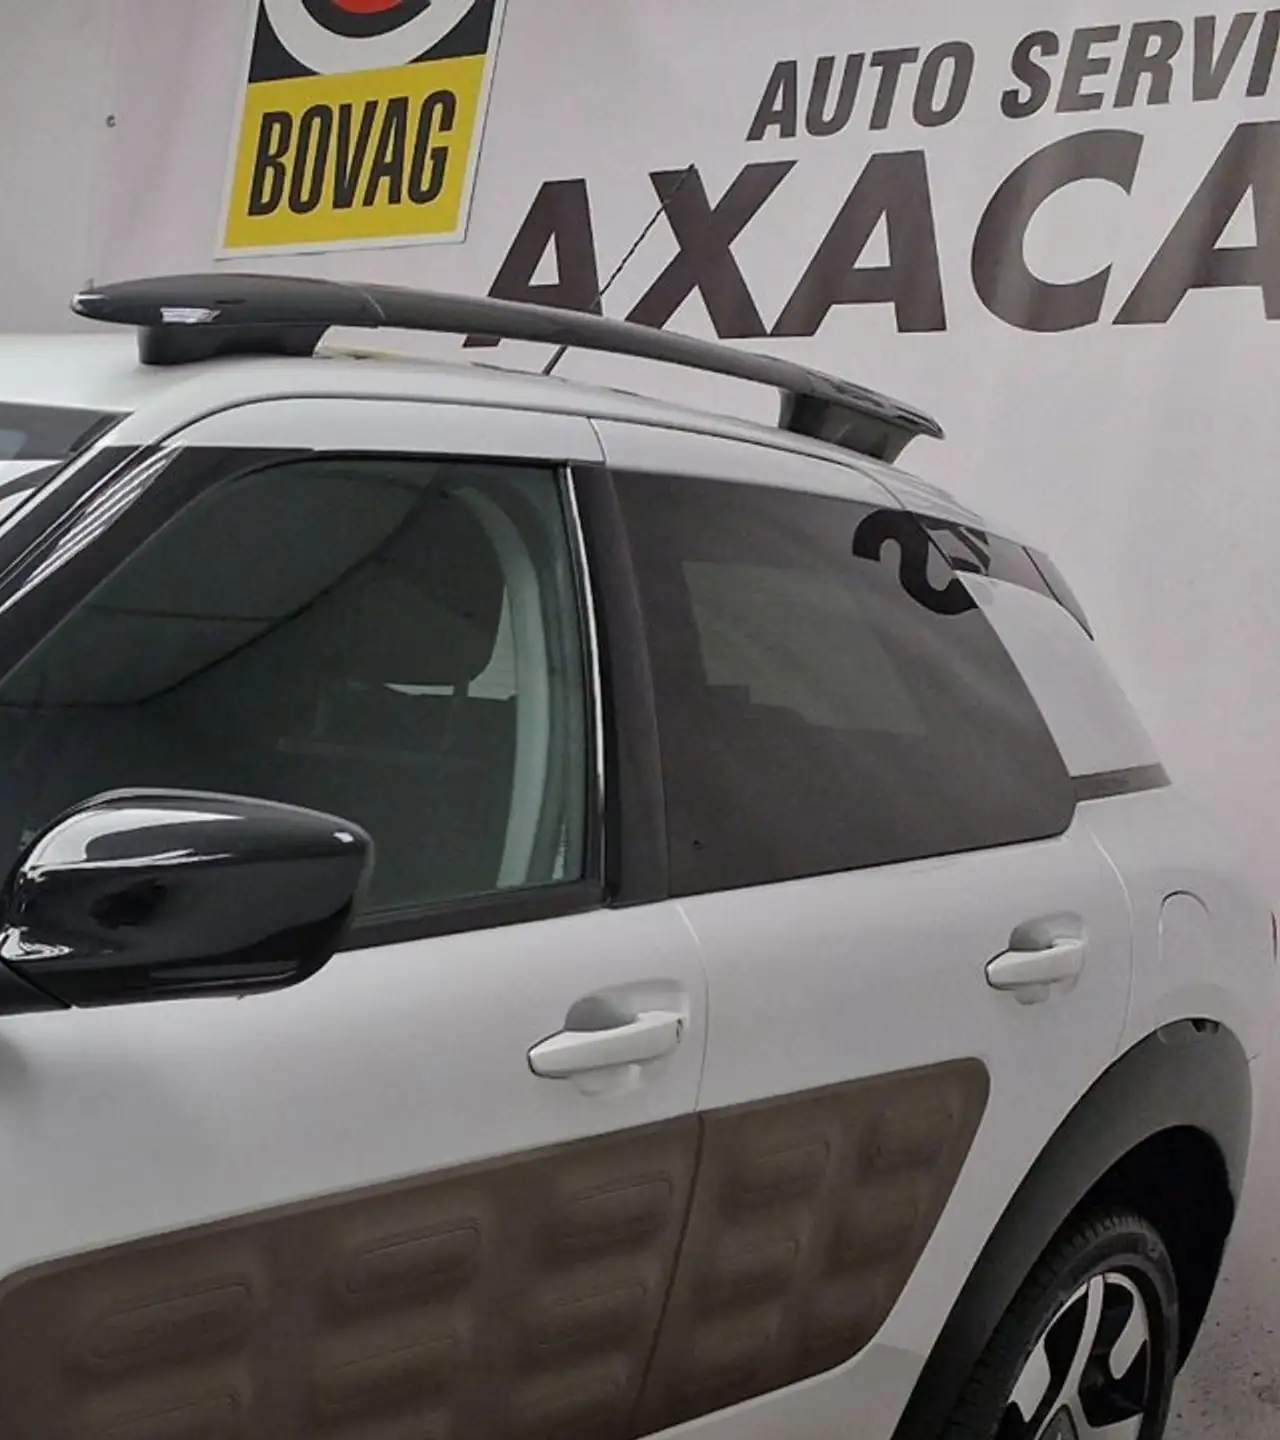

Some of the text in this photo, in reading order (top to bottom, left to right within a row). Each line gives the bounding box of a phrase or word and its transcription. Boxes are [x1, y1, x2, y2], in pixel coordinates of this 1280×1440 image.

[746, 9, 1280, 141] AUTO SERVI
[247, 89, 458, 216] BOVAG
[462, 120, 1280, 348] AXACA
